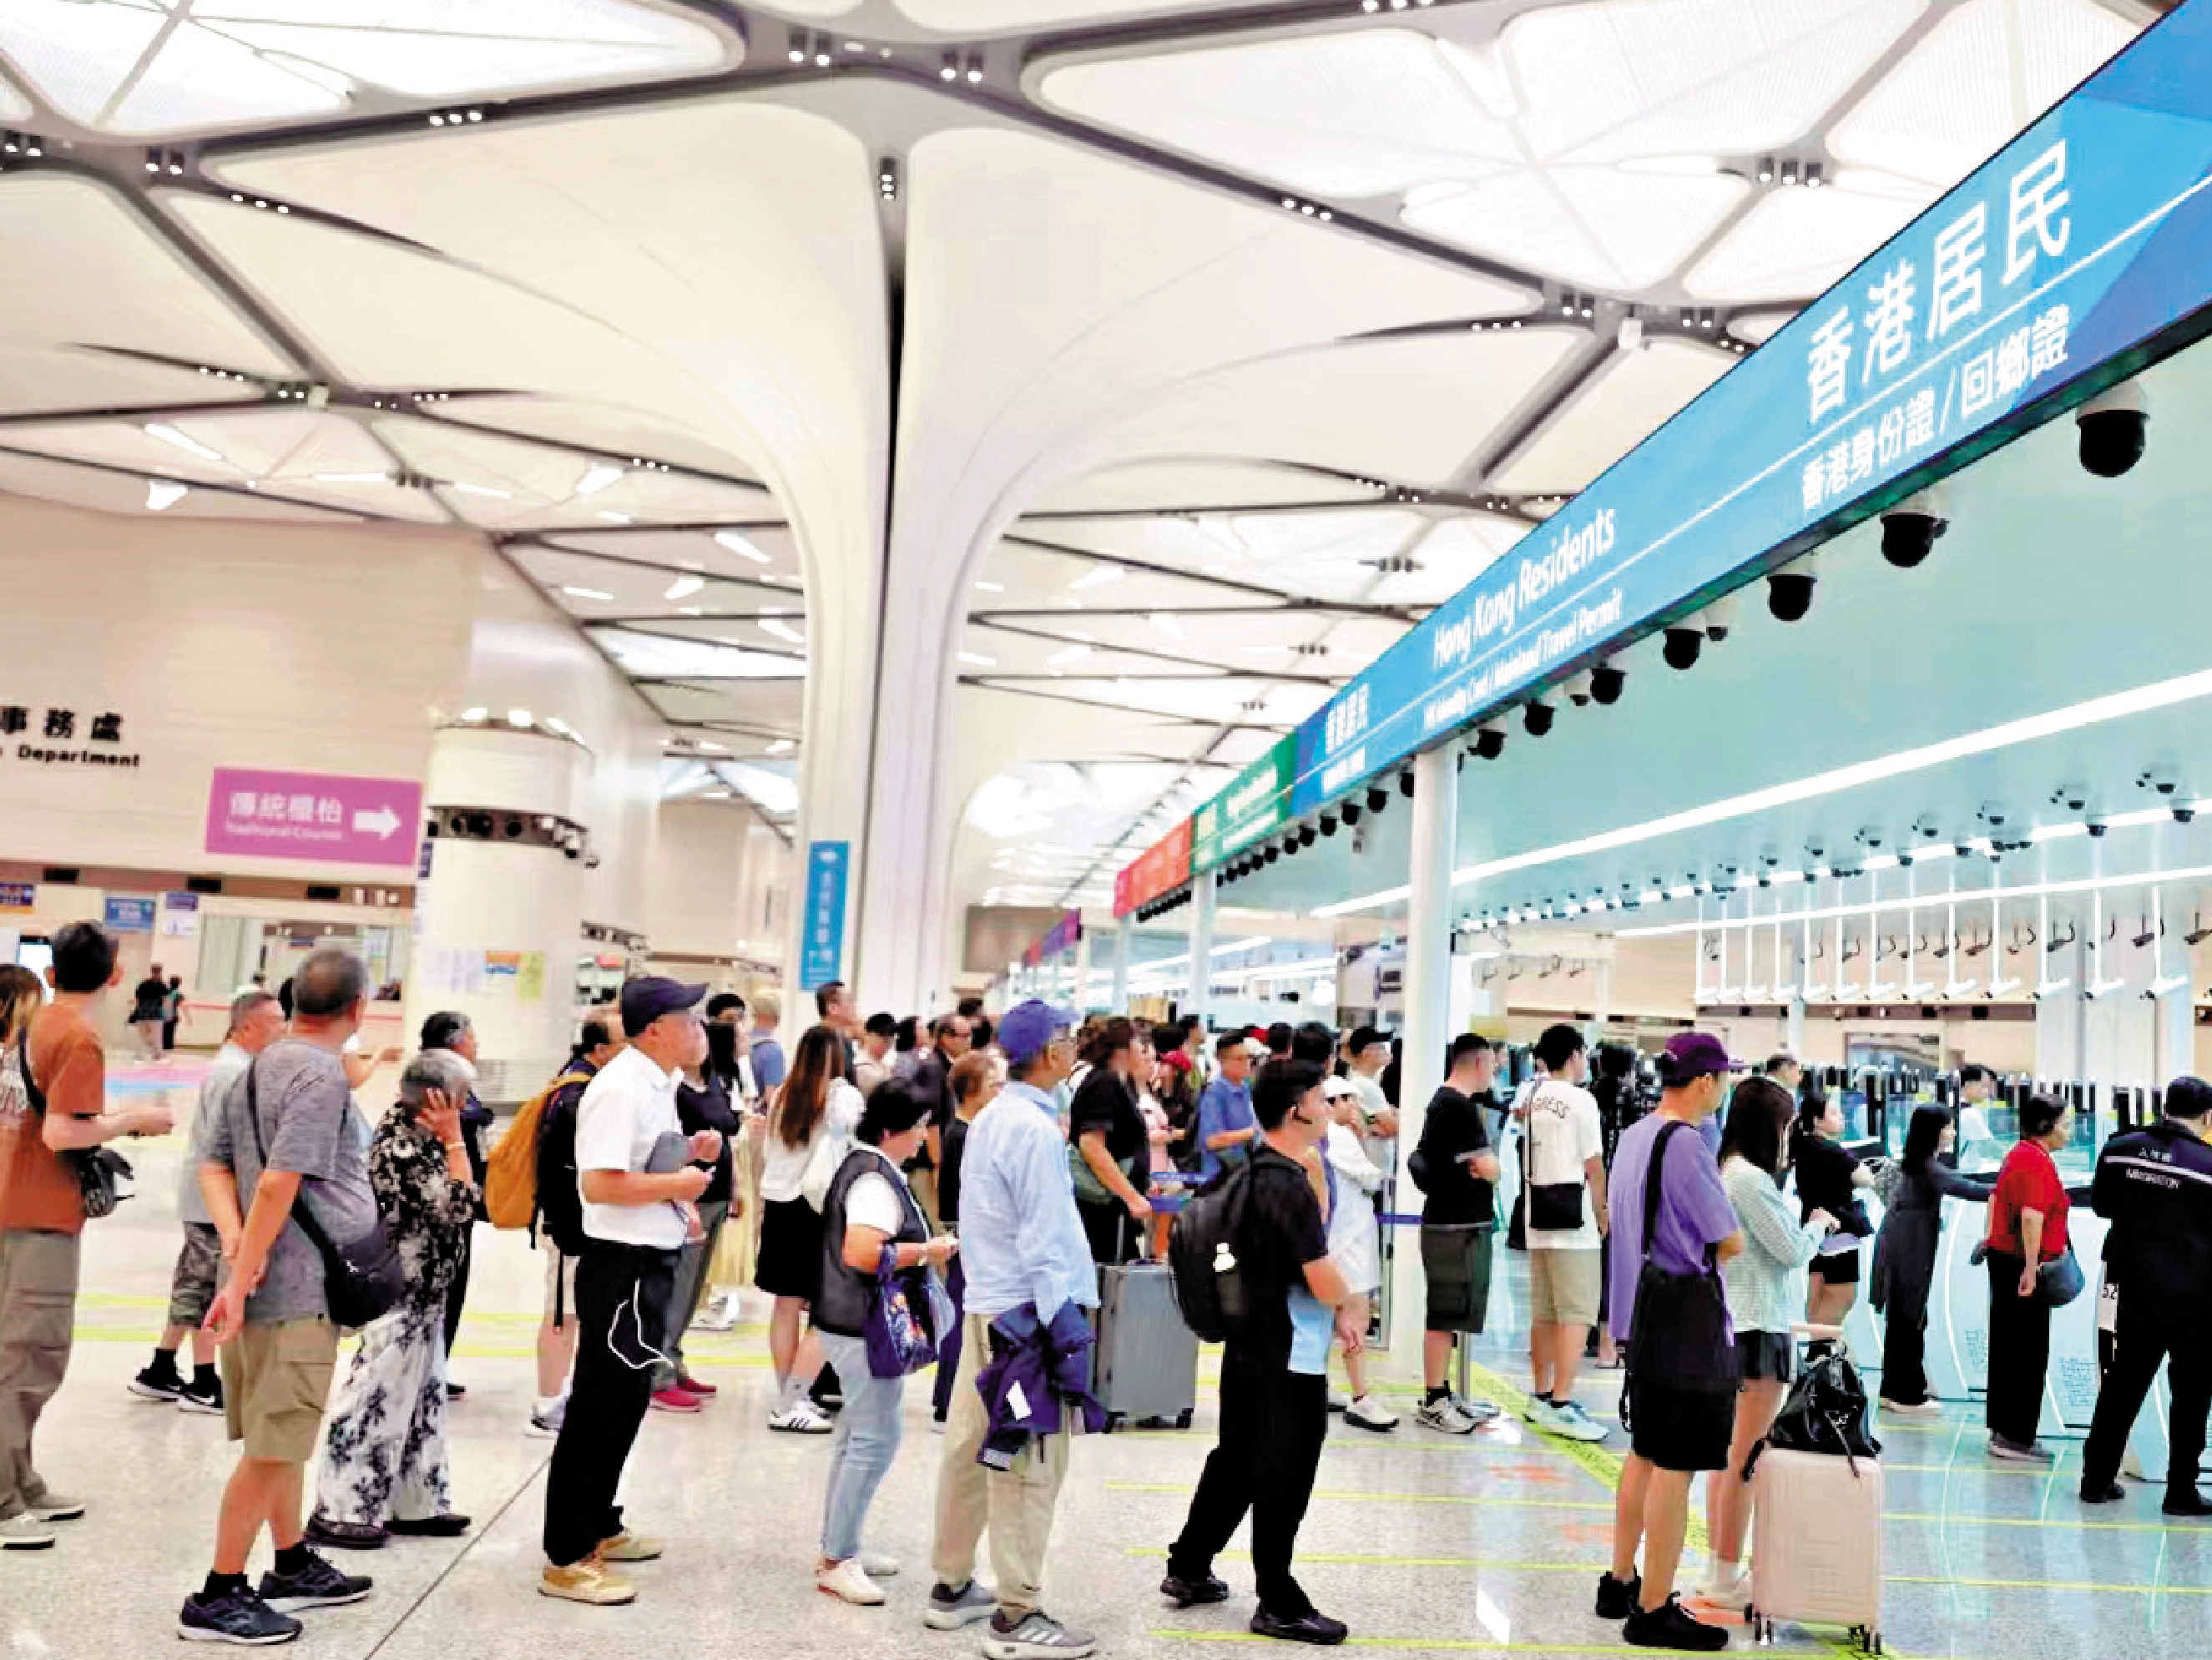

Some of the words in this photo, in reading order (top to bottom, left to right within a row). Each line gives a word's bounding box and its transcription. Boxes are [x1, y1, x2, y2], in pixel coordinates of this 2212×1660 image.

[1808, 138, 2071, 426] 香港居民
[1433, 614, 1472, 669] Hong
[1475, 582, 1515, 639] Kong
[1518, 508, 1615, 611] Residents
[18, 744, 140, 769] Department
